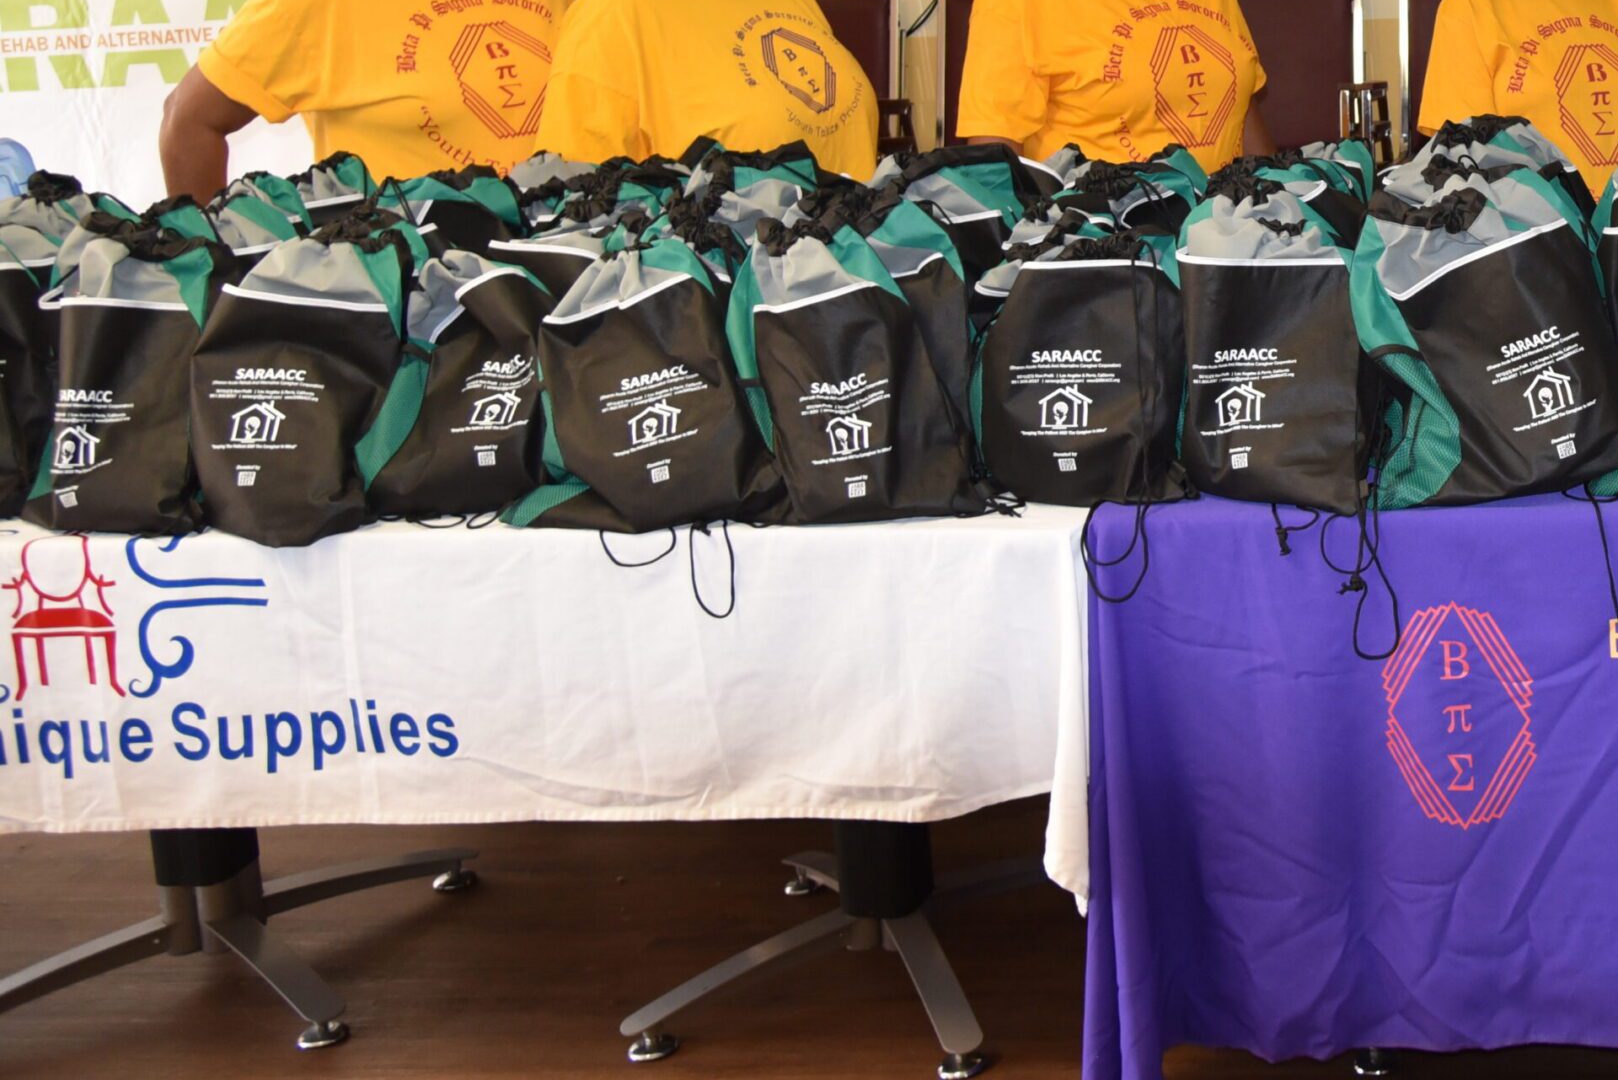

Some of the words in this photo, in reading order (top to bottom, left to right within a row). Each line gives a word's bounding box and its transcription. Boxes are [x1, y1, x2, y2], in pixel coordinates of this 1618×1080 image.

[1129, 2, 1171, 22] Sigma
[54, 34, 92, 51] AND
[97, 27, 212, 48] ALTERNATIVE
[1112, 20, 1134, 39] Pi
[396, 33, 420, 75] Beta
[1102, 43, 1125, 83] Beta
[1506, 55, 1530, 94] Beta
[1519, 36, 1540, 57] Pi
[1536, 15, 1583, 40] Sigma
[1214, 348, 1278, 362] SARAACC
[1500, 326, 1561, 358] SARAACC
[1030, 350, 1102, 364] SARAACC
[235, 368, 306, 381] SARAACC
[620, 364, 688, 391] SARAACC
[1439, 640, 1471, 681] B
[0, 708, 154, 780] ique
[171, 698, 460, 774] Supplies
[1447, 753, 1475, 792] Σ
